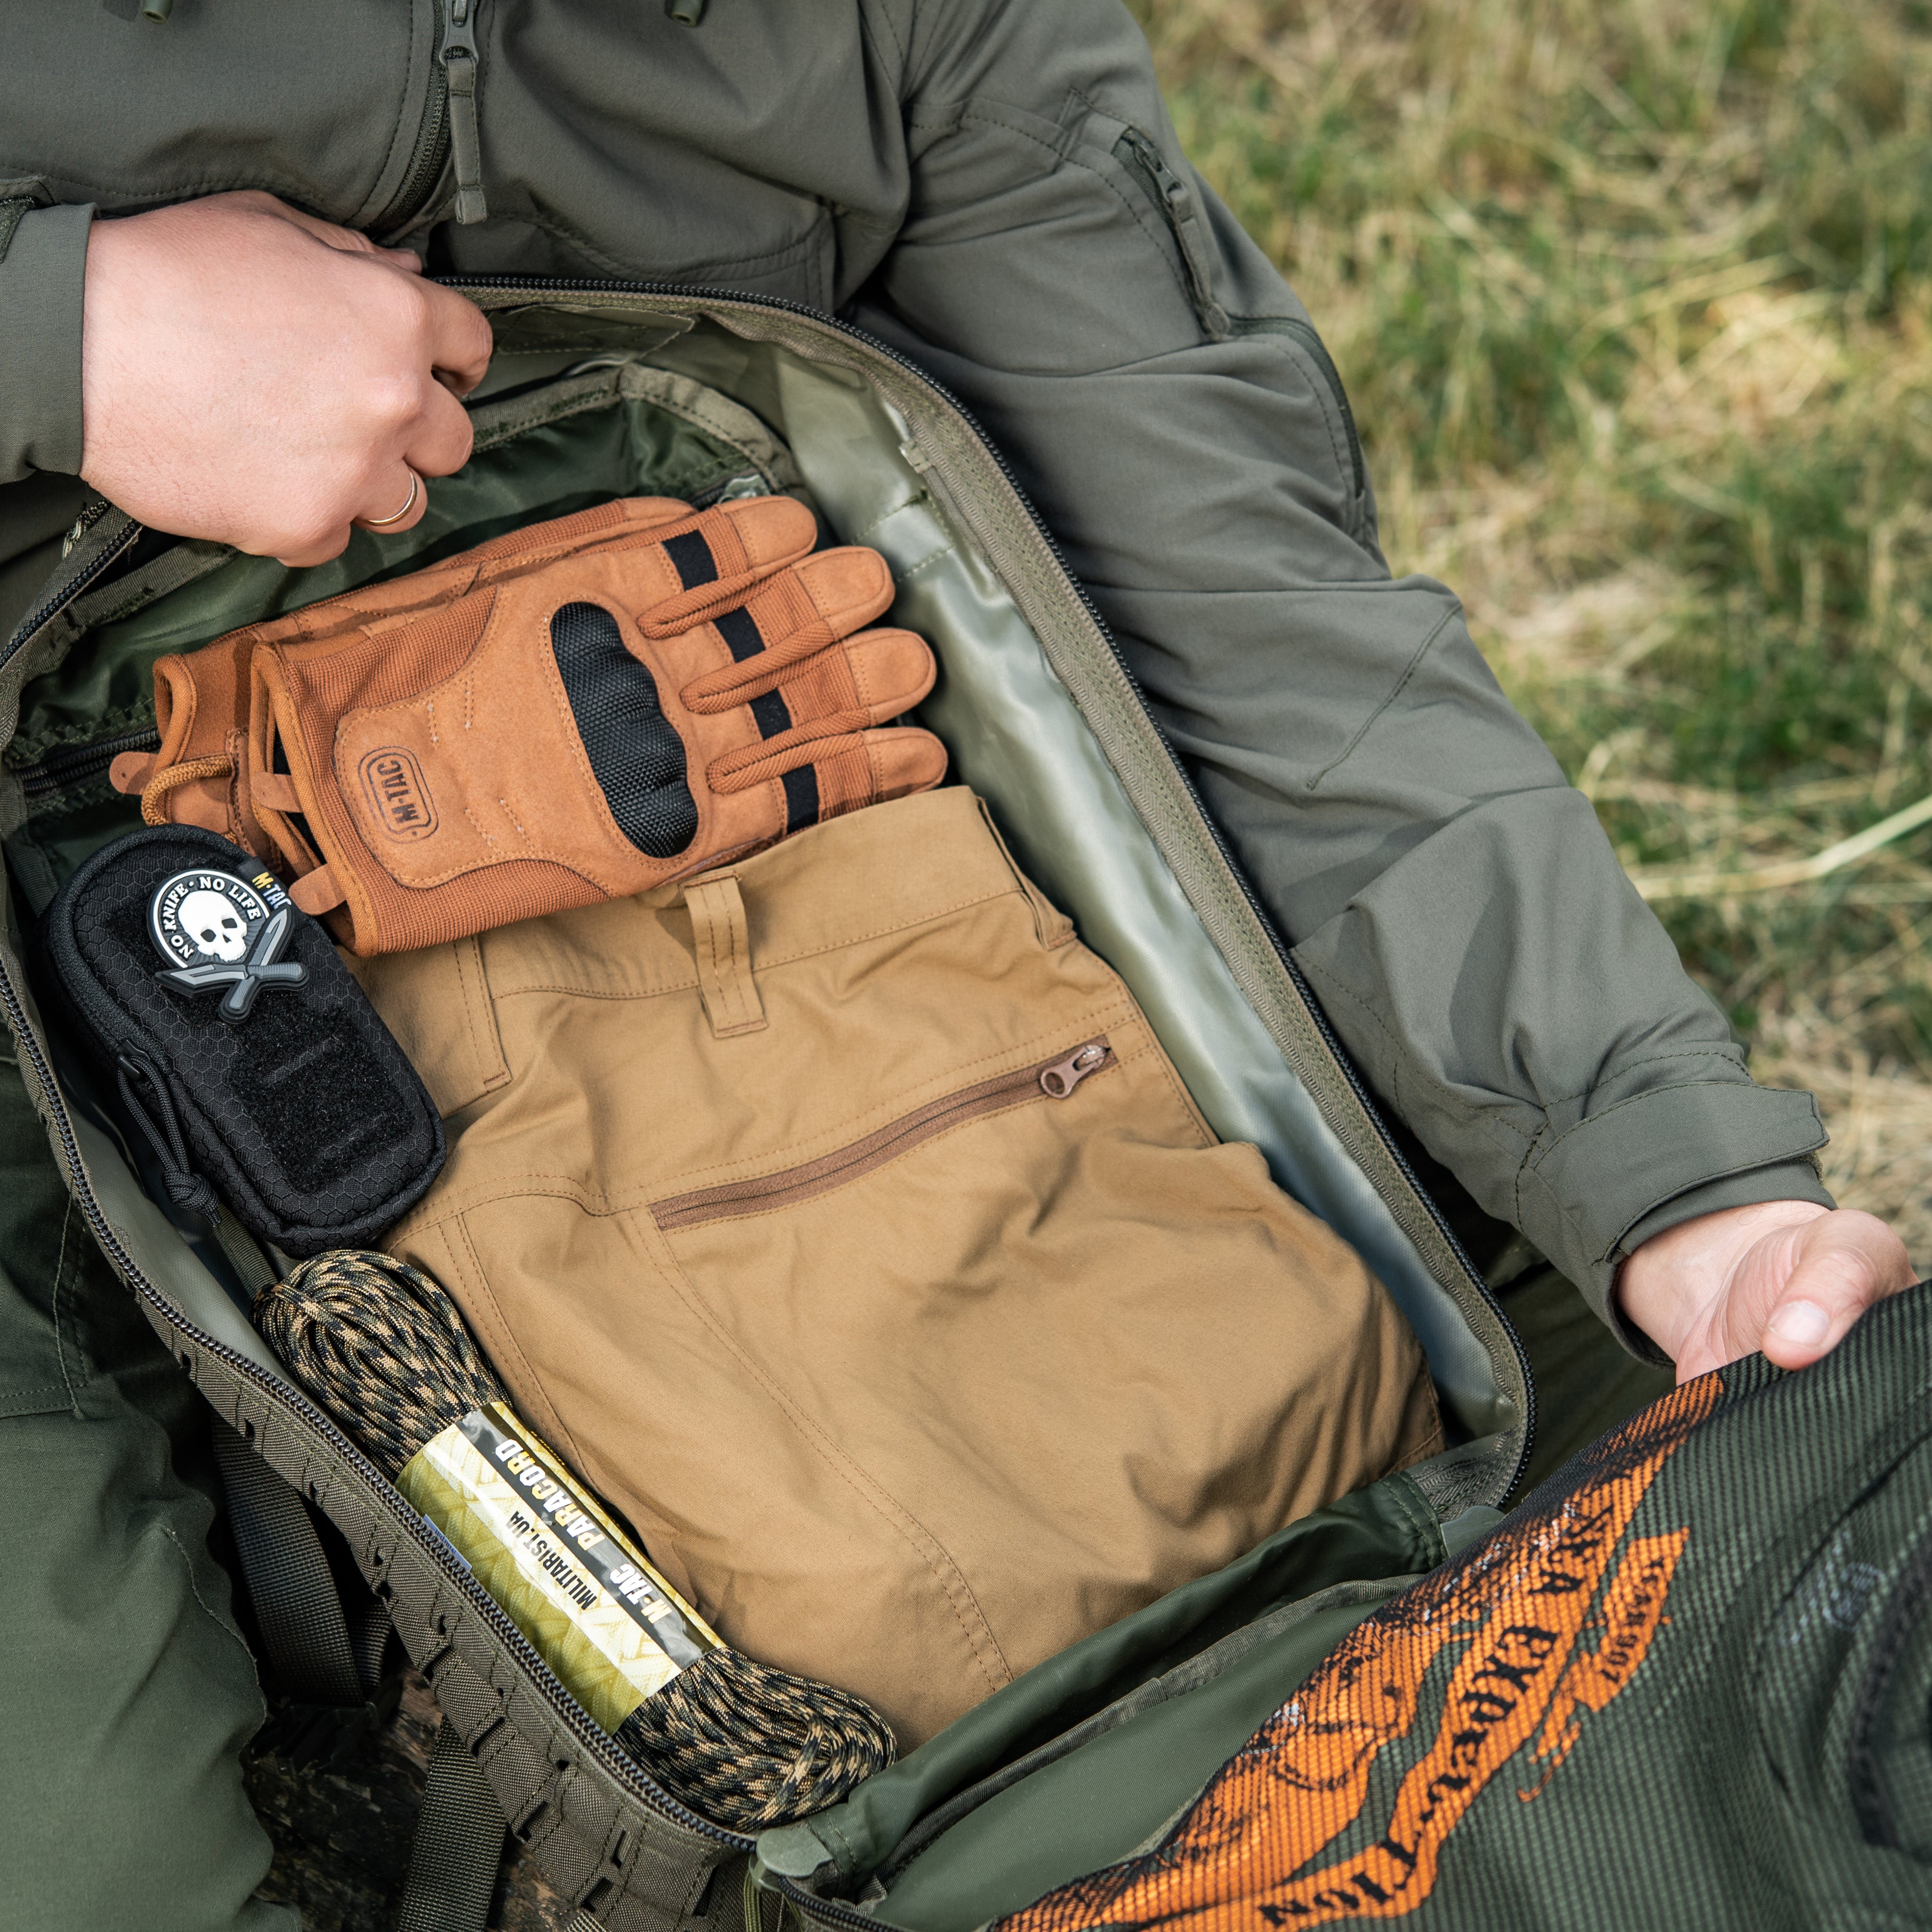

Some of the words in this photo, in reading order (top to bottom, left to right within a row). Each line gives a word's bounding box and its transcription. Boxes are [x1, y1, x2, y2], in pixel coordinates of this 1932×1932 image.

[162, 882, 189, 933] KNIFE
[199, 876, 225, 891] NO
[228, 885, 261, 921] LIFE
[171, 935, 194, 959] NO
[494, 1439, 605, 1552] PARACORD
[505, 1510, 597, 1610] MILITARIST.UA
[1260, 1625, 1557, 1925] EXPETION
